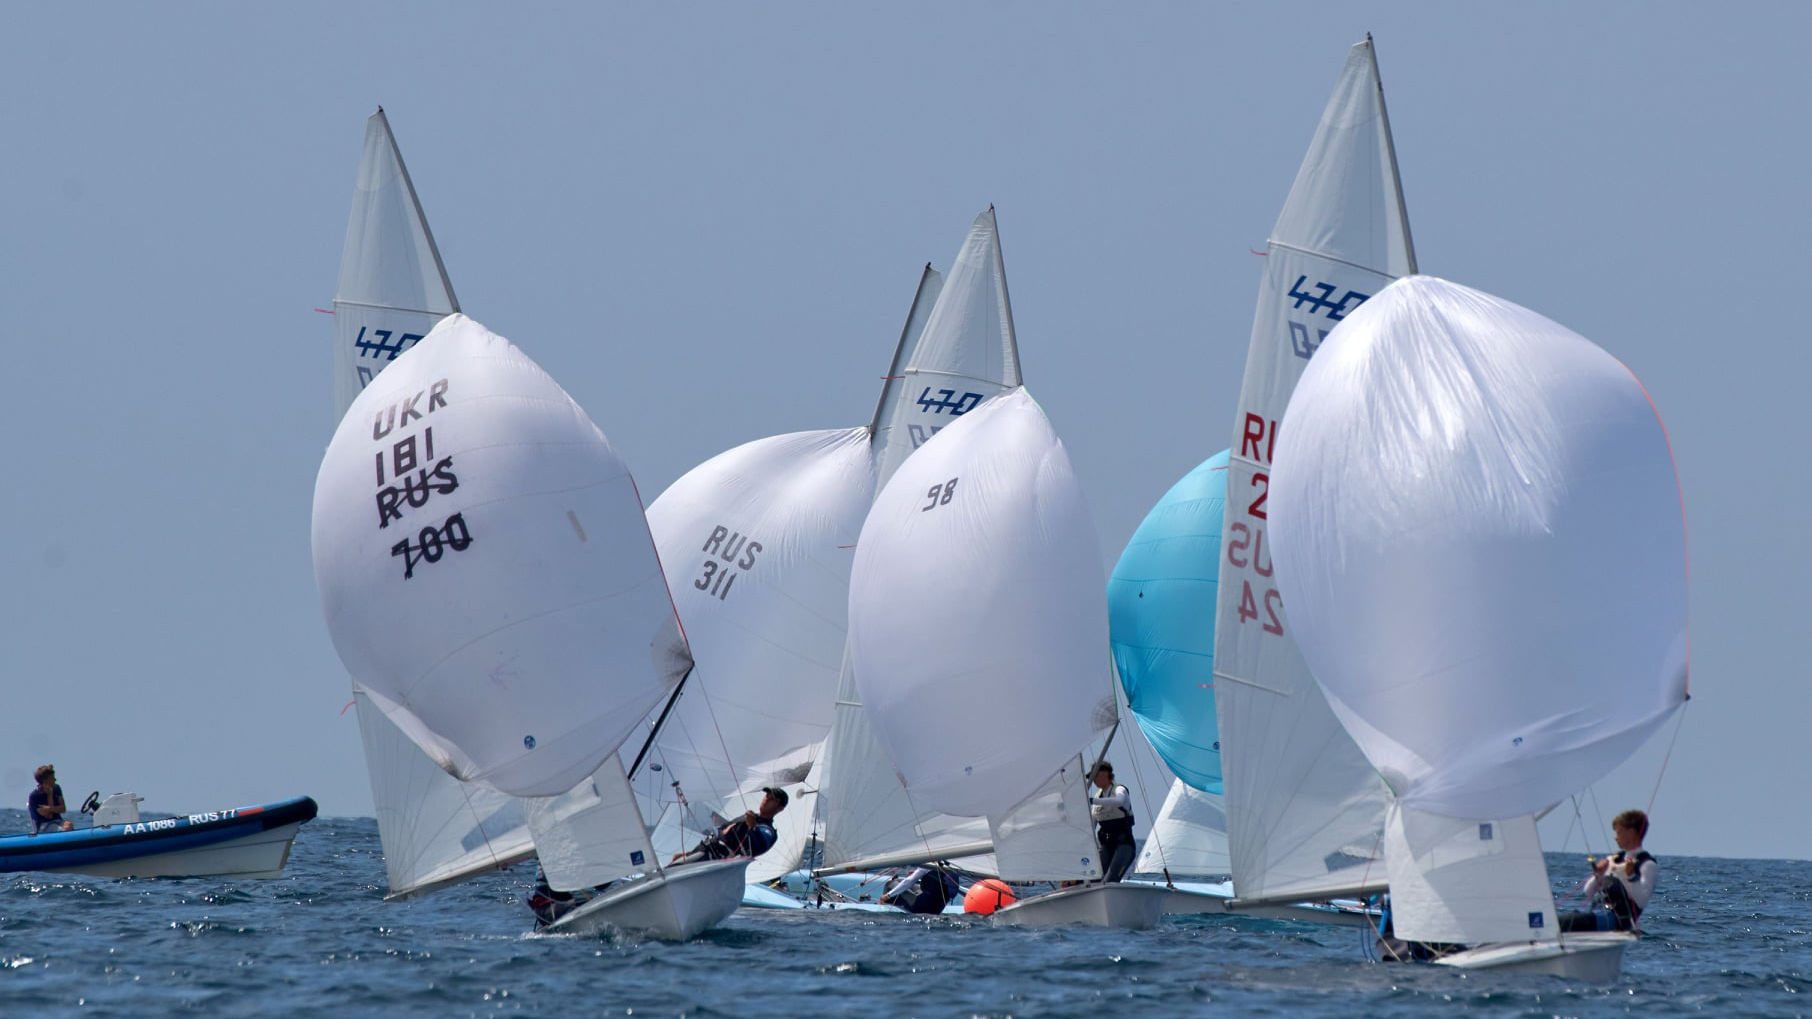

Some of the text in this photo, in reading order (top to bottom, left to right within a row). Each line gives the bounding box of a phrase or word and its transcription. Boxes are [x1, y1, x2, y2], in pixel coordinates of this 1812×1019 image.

[373, 378, 449, 441] UKR
[916, 386, 985, 416] 470
[376, 456, 460, 530] RUS
[922, 477, 959, 512] 98
[1248, 473, 1270, 520] 2
[702, 524, 763, 571] RUS
[694, 560, 738, 601] 311
[148, 818, 176, 832] 1086
[188, 812, 219, 826] RUS
[221, 809, 236, 819] 77
